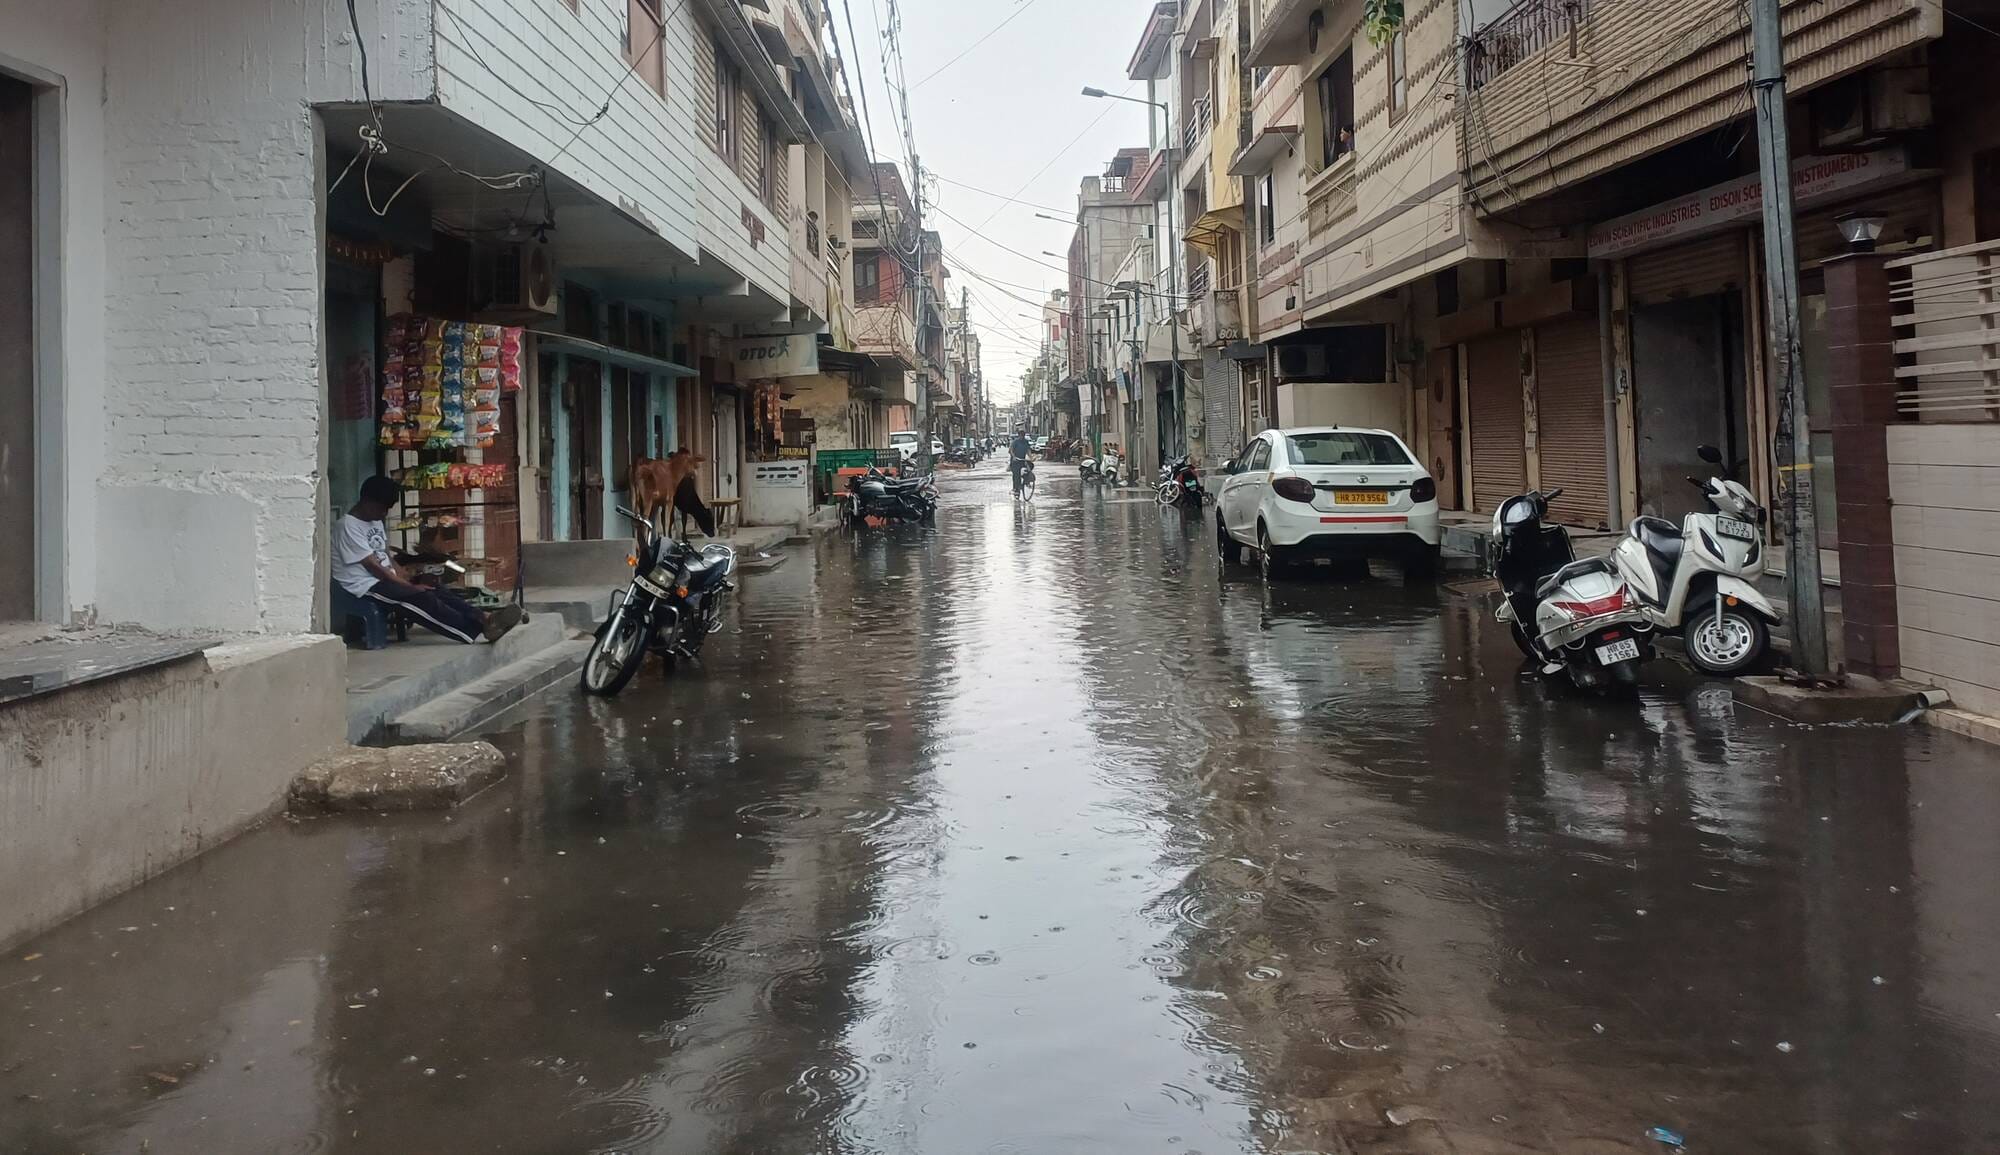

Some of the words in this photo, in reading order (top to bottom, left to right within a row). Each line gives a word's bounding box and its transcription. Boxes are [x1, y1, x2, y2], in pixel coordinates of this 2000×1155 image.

[1710, 189, 1741, 211] EDISON
[1793, 153, 1869, 186] INSTRUMENTS
[1589, 231, 1611, 248] EDWIN
[1612, 218, 1650, 241] SCIENTIFIC
[1652, 203, 1701, 229] INDUSTRIES
[1219, 328, 1239, 340] BOX
[739, 347, 776, 360] DTDC
